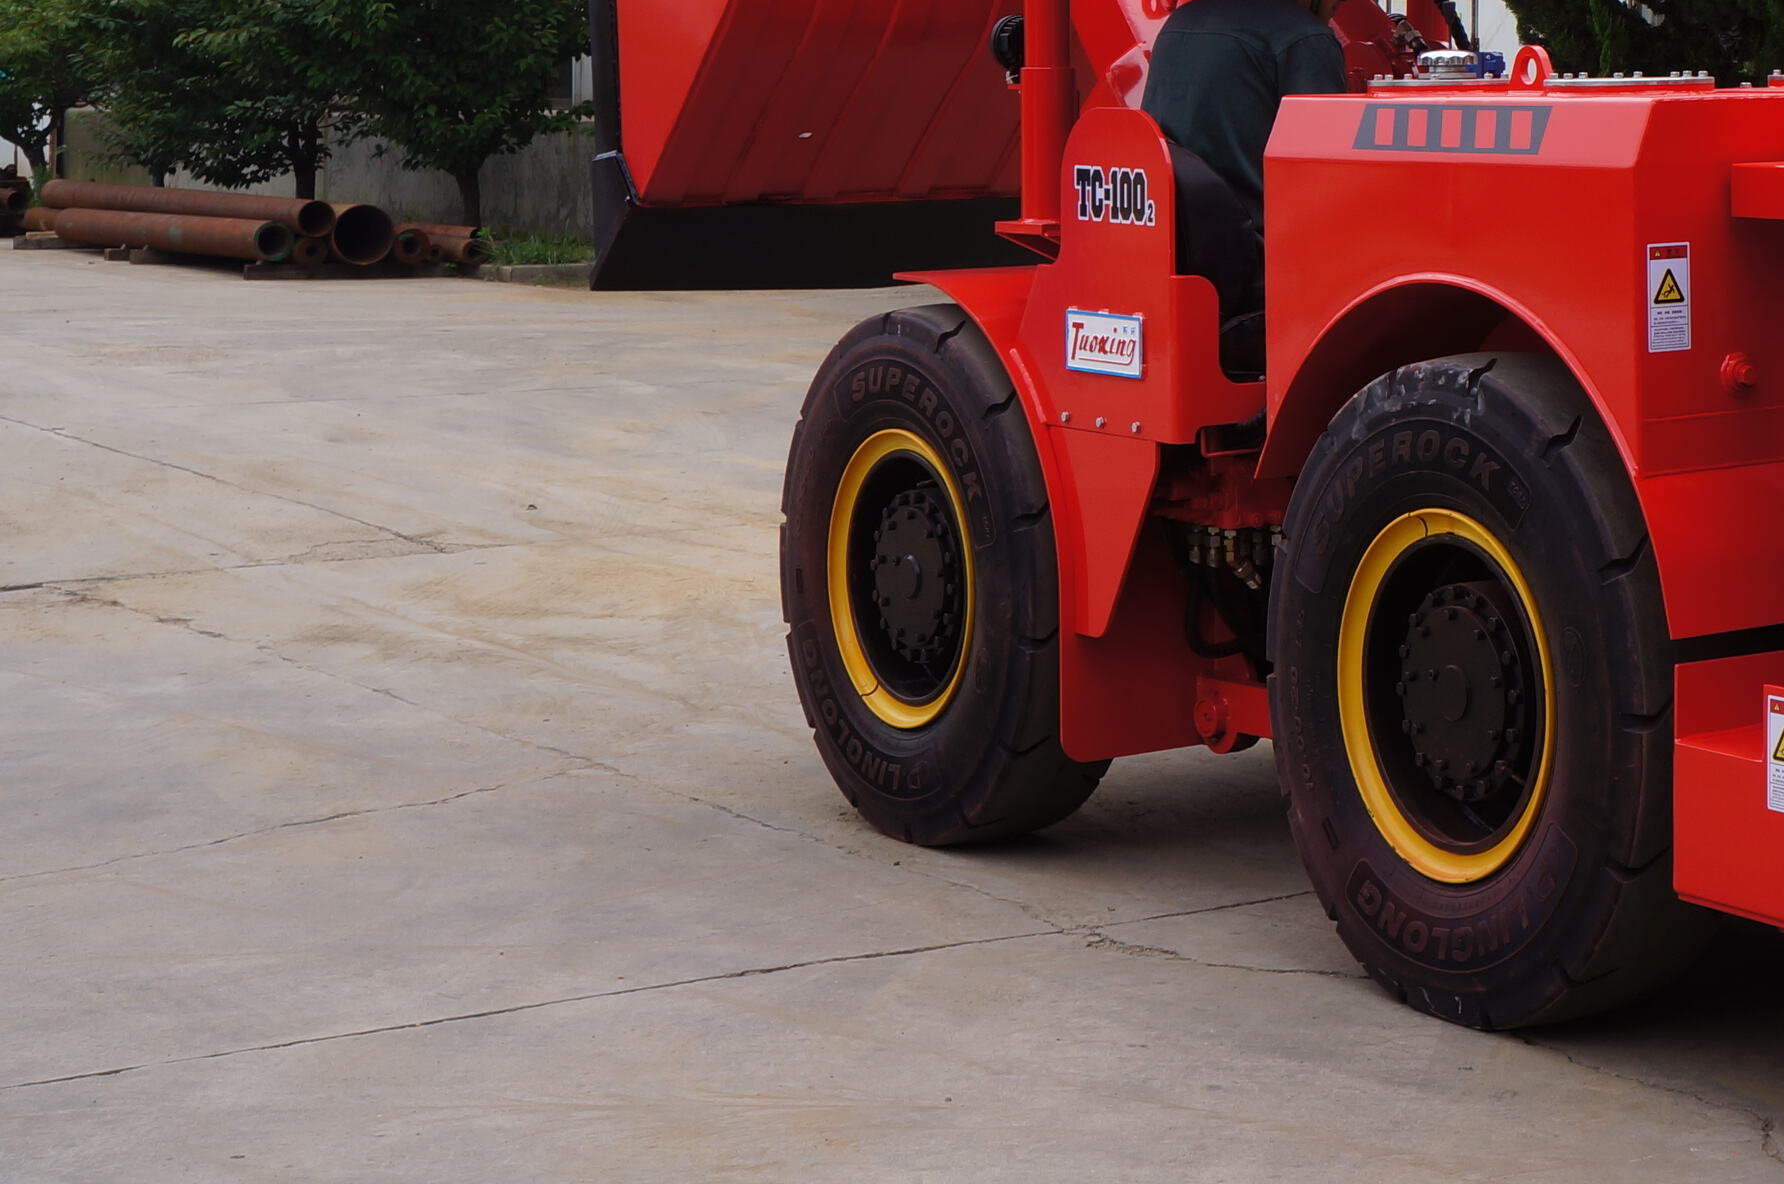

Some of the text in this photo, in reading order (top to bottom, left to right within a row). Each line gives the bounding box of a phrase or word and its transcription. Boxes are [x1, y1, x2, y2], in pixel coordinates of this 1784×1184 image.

[1071, 322, 1136, 365] Tuoxing
[851, 366, 982, 507] SUPEROCK
[1308, 427, 1502, 559] SUPEROCK
[803, 638, 902, 793] LINGLONG
